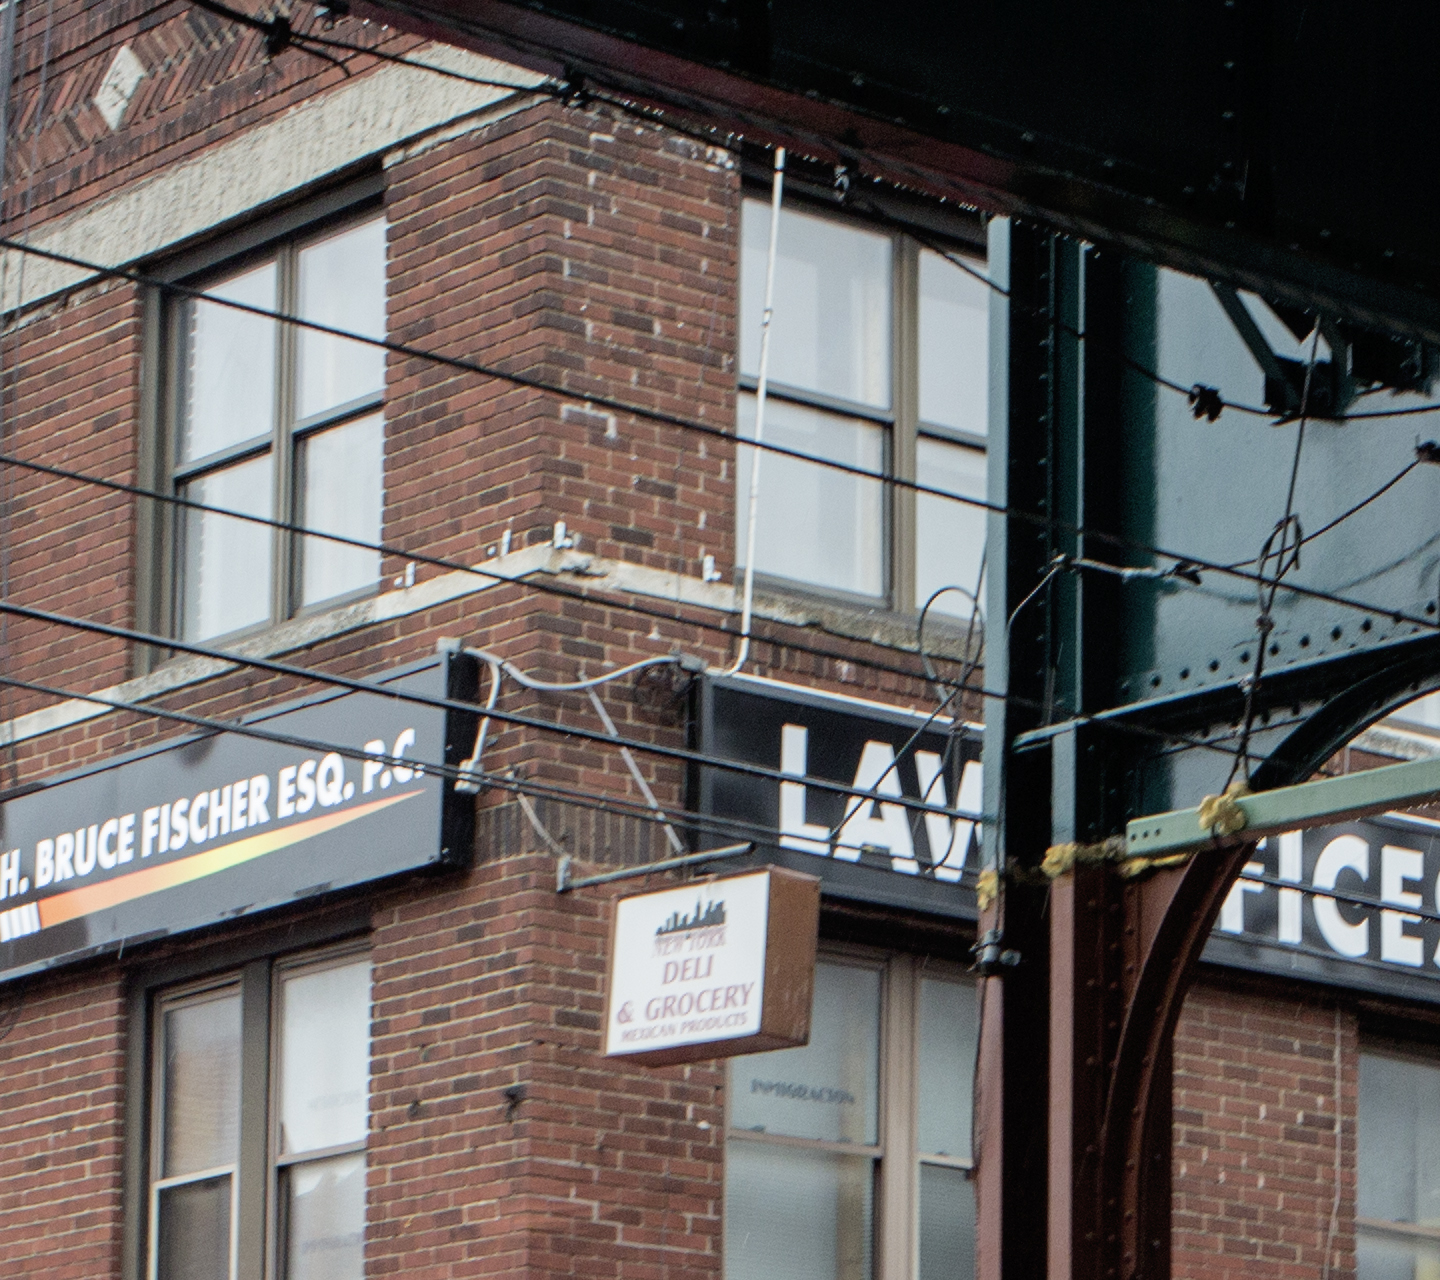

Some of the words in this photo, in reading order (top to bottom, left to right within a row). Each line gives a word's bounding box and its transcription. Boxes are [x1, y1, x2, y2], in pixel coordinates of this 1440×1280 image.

[35, 814, 135, 888] BRUCE
[141, 774, 271, 857] FISCHER
[277, 752, 356, 818] ESQ.
[362, 728, 426, 794] P.C.
[661, 954, 714, 985] DELI
[616, 999, 635, 1024] &
[645, 981, 756, 1022] GROCERY
